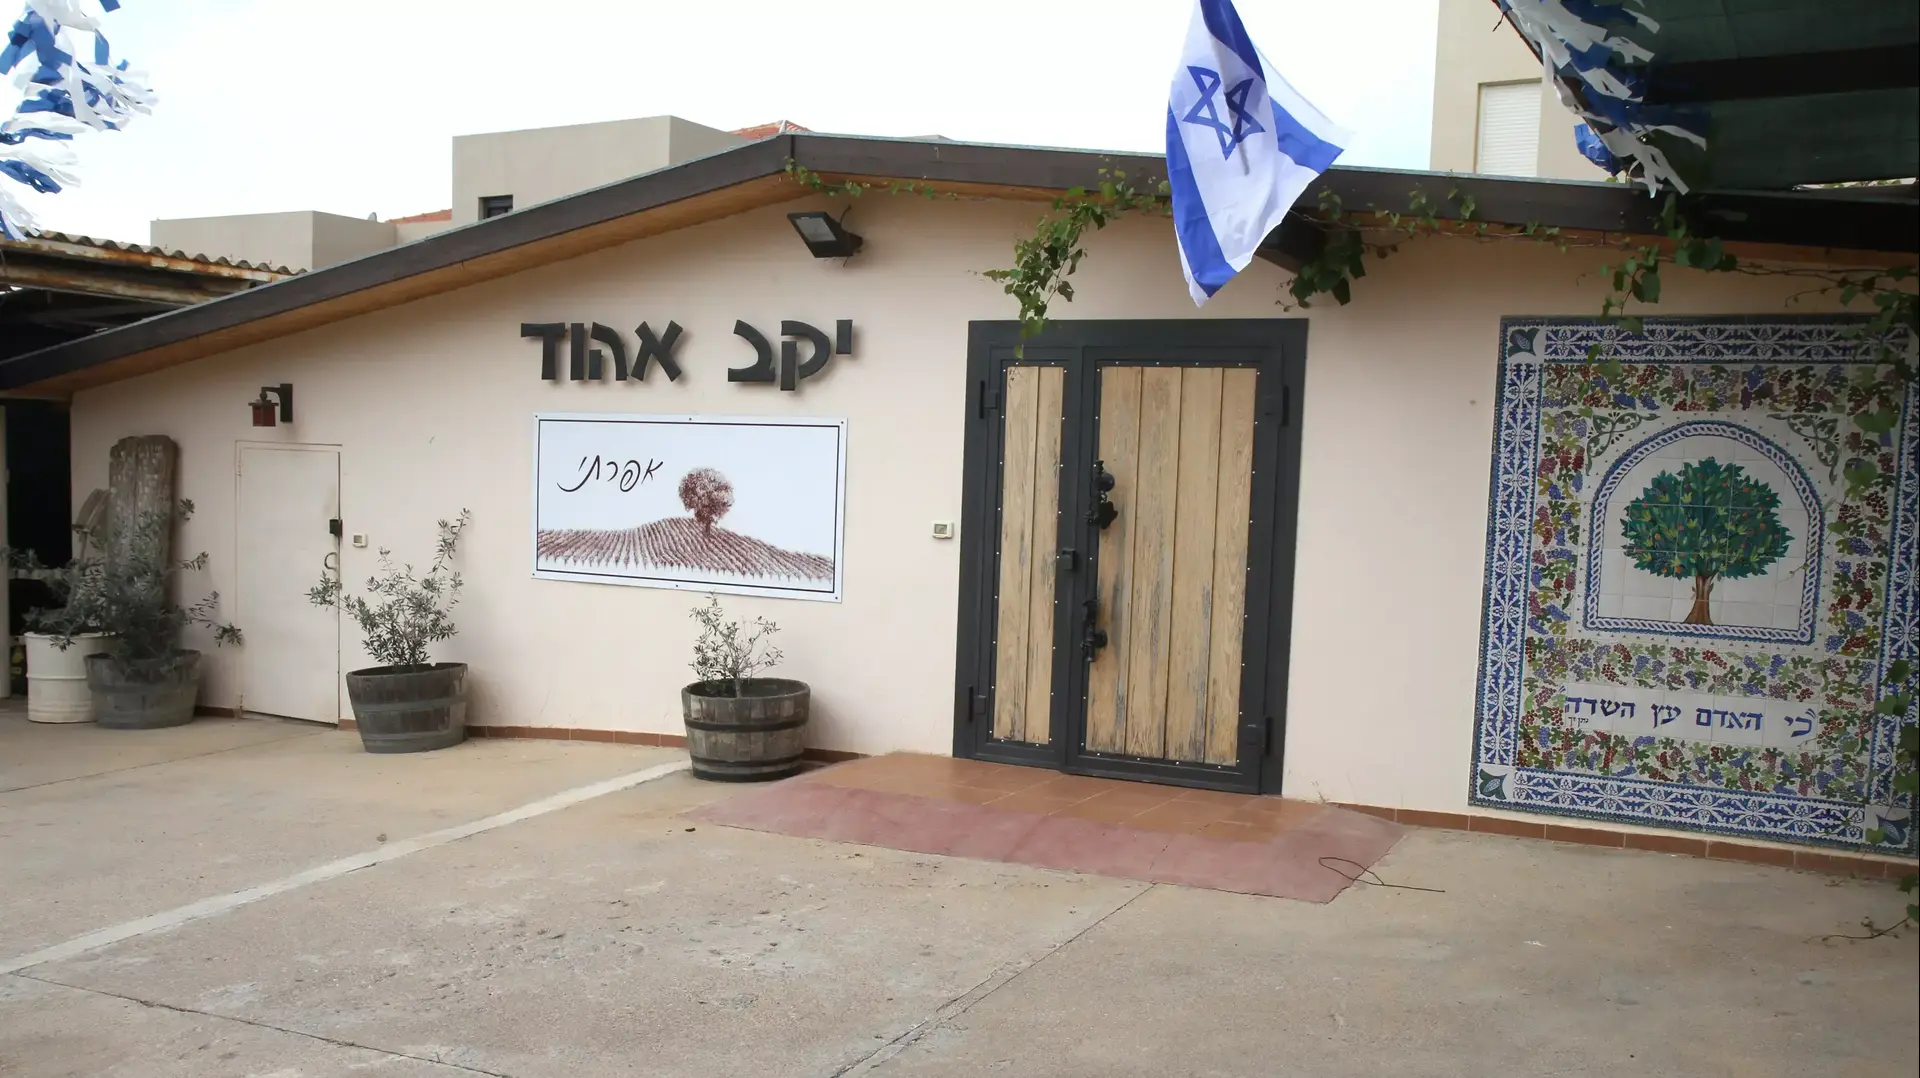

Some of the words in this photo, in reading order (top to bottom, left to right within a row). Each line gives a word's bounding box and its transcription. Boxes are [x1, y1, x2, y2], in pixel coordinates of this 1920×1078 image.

[520, 319, 684, 382] אהוד
[727, 319, 854, 391] יקב
[556, 454, 664, 492] אפרתי
[1650, 703, 1681, 729] עץ
[1696, 707, 1763, 731] האדם
